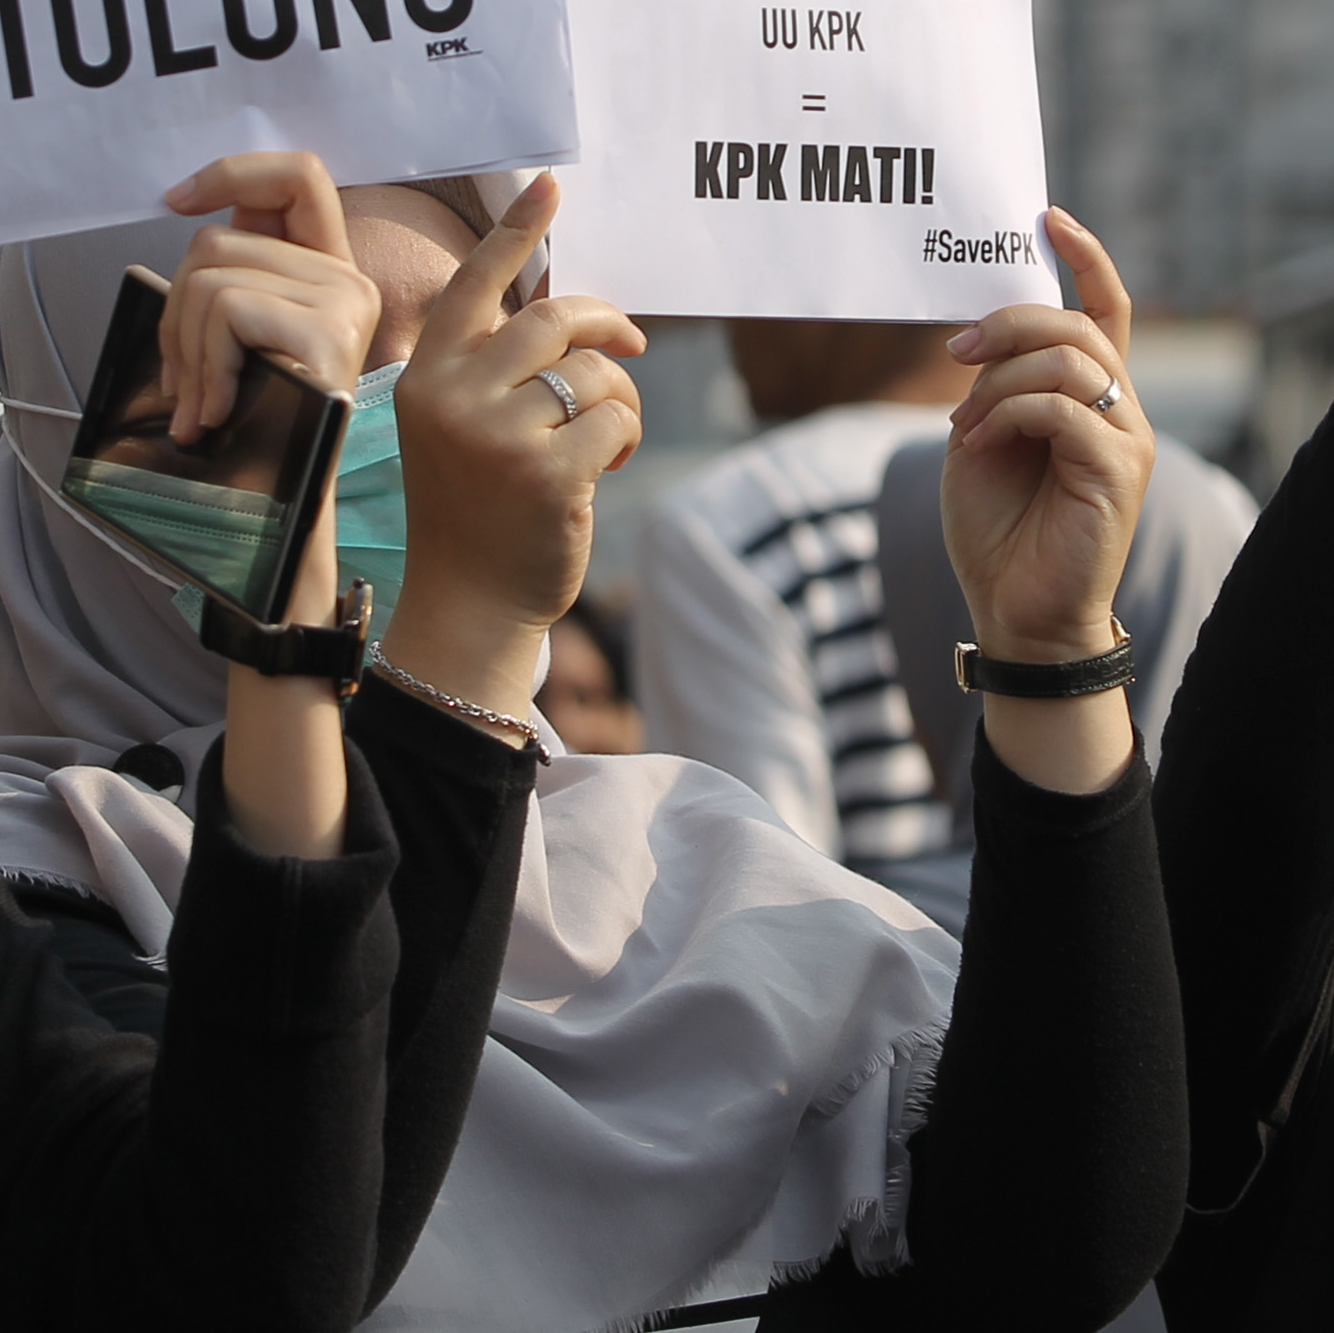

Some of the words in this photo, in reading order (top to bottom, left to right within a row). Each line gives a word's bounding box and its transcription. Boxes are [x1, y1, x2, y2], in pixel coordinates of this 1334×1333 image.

[426, 36, 470, 57] KPK
[761, 7, 798, 50] UU
[807, 8, 866, 52] KPK
[801, 94, 827, 112] =
[693, 140, 789, 202] KPK
[799, 144, 936, 205] MATI!
[922, 228, 1038, 266] #SaveKPK
